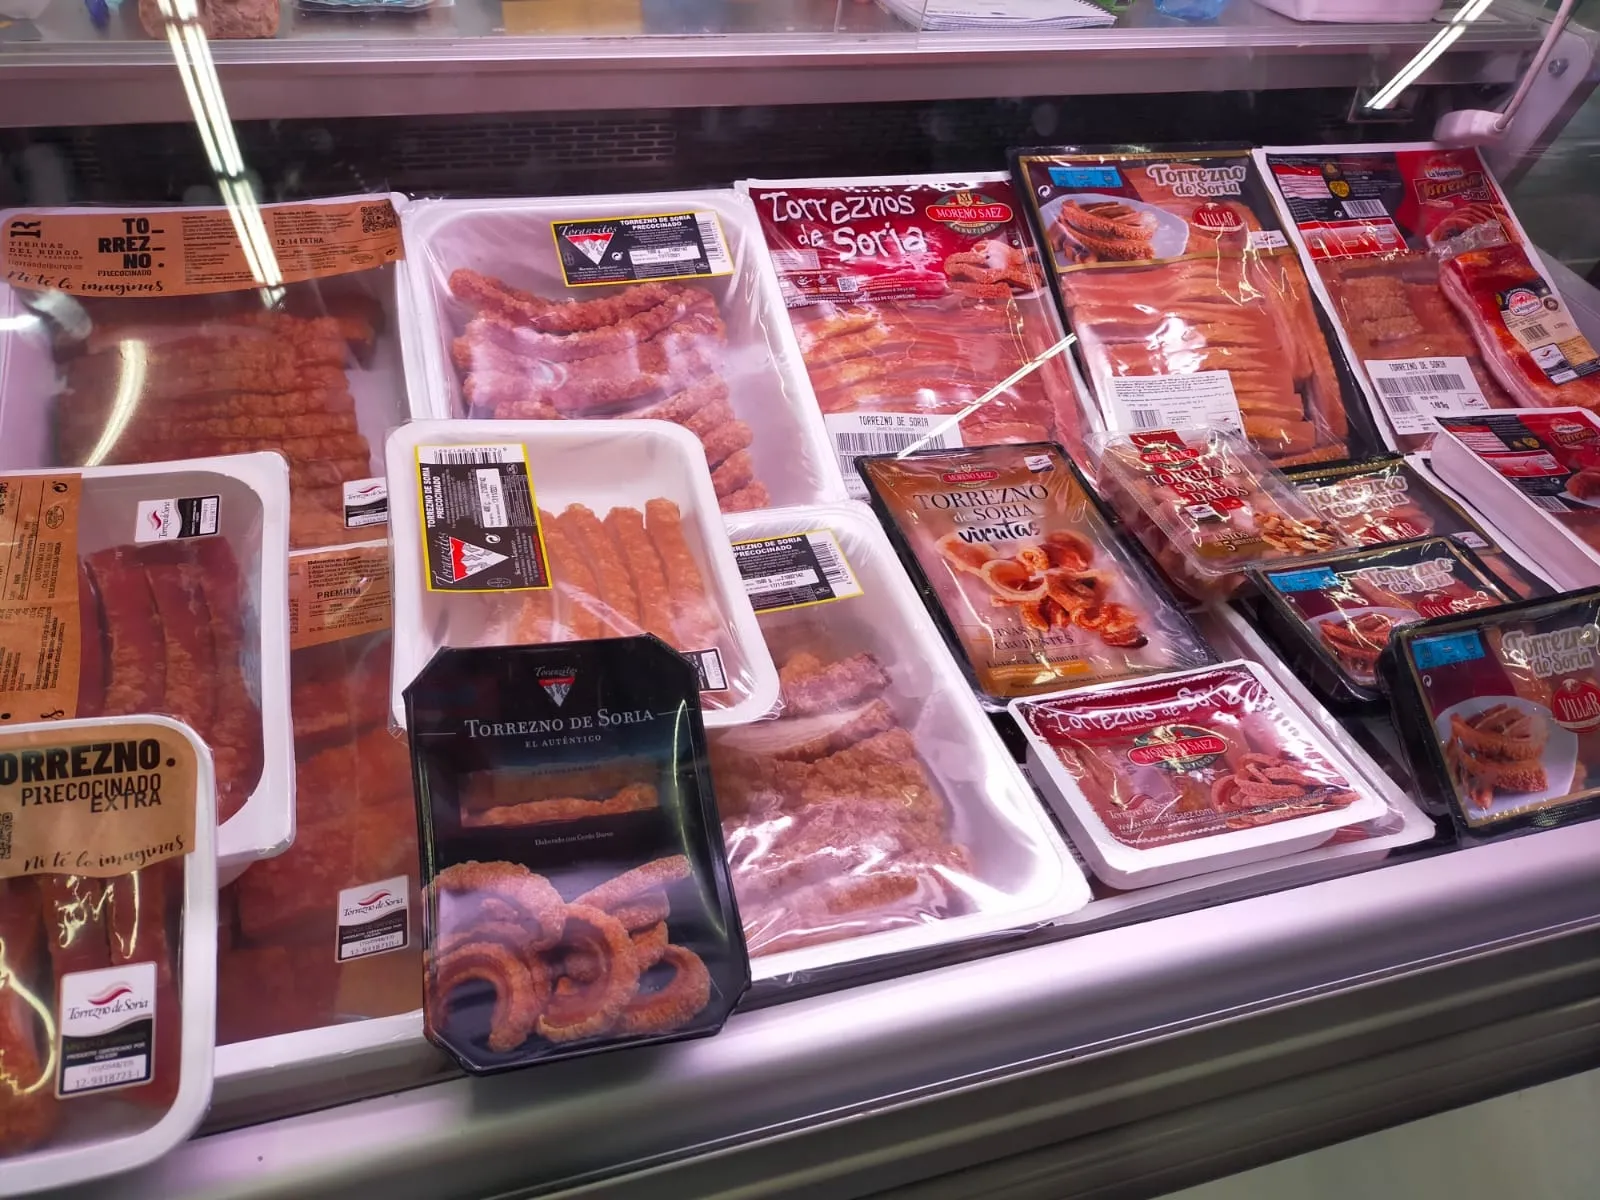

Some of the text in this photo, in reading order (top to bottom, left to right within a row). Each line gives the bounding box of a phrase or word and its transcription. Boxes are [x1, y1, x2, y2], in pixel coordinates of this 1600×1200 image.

[1148, 164, 1245, 187] Torrezno
[1175, 181, 1240, 195] de Soria
[759, 191, 915, 224] Torreznos
[936, 207, 1004, 219] MORENO SAEZ
[620, 218, 658, 226] TORREZNO
[670, 214, 692, 222] SORIA
[632, 222, 682, 230] PRECOCINADO
[1199, 211, 1236, 227] VILLAR
[797, 224, 823, 247] de
[833, 222, 928, 262] Soria
[98, 269, 152, 277] PRECOCINADO
[82, 280, 164, 295] imaginas
[1388, 360, 1447, 372] TORREZNO DE SORIA
[858, 415, 929, 427] TORREZNO DE SORIA
[422, 467, 436, 527] TORREZNO DE SORIA
[433, 476, 444, 518] PRECOCINADO
[913, 484, 1049, 510] TORREZNO
[1190, 486, 1249, 502] DADOS
[953, 504, 1036, 524] de SORIA
[959, 519, 1041, 544] virutas
[776, 536, 802, 546] SORIA
[1222, 540, 1236, 551] 5
[734, 544, 792, 557] PRECOCINADO
[317, 588, 361, 599] PREMIUM
[1504, 625, 1598, 652] Torrezno
[1533, 651, 1592, 674] de Soria
[464, 708, 655, 738] TORREZNO DE SORIA
[524, 734, 602, 749] EL AUTÉNTICO
[1188, 738, 1216, 751] SAEZ
[22, 772, 162, 807] PRECOCINADO
[90, 790, 162, 814] EXTRA
[24, 854, 48, 872] ni
[99, 834, 186, 868] imaginas
[344, 898, 404, 917] Torrezno de Soria
[68, 998, 148, 1020] Torrezno de Soria
